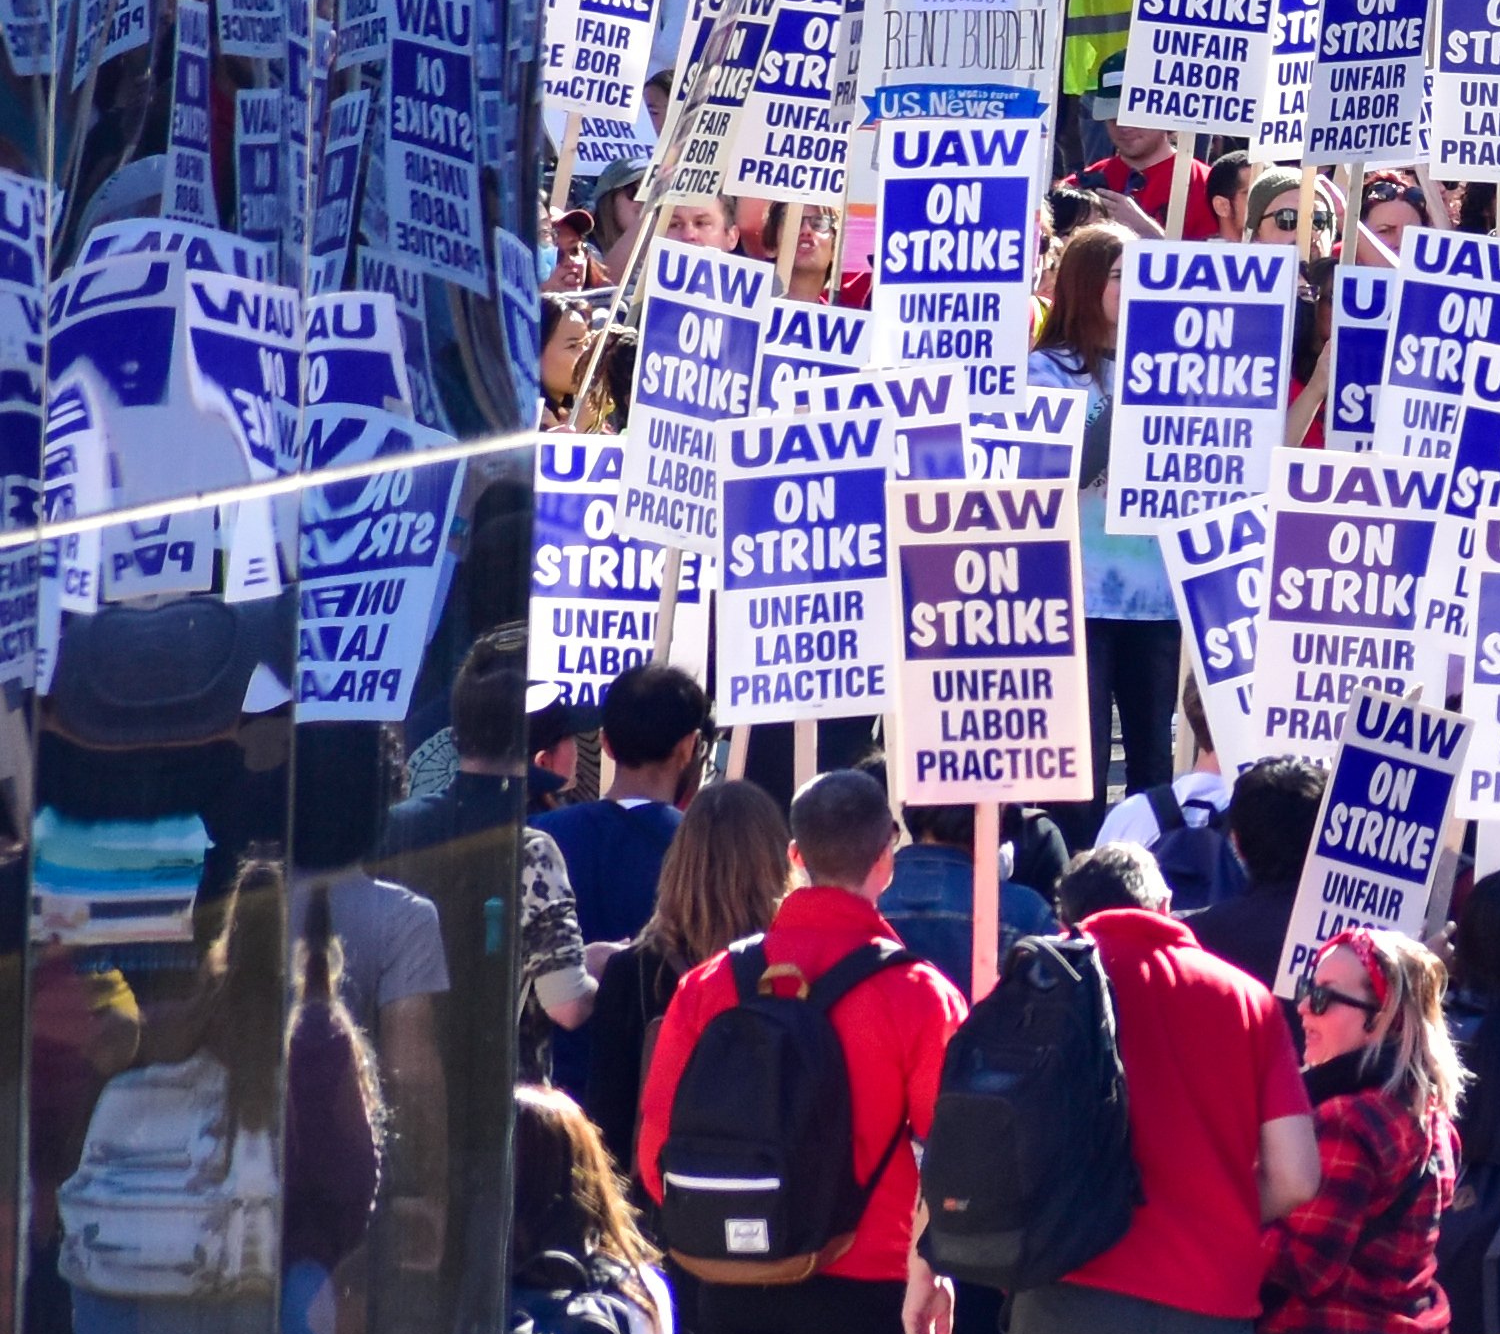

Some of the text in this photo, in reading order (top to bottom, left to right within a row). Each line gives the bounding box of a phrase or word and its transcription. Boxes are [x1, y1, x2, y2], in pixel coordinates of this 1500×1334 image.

[884, 8, 1047, 71] RENT BURDEN
[880, 91, 926, 118] U.S.
[904, 488, 1063, 533] UAW
[953, 546, 1019, 594] ON
[909, 597, 1070, 648] STRIKE
[932, 668, 1052, 702] UNFAIR
[940, 707, 1047, 741] LABOR
[916, 747, 1075, 782] PRACTICE
